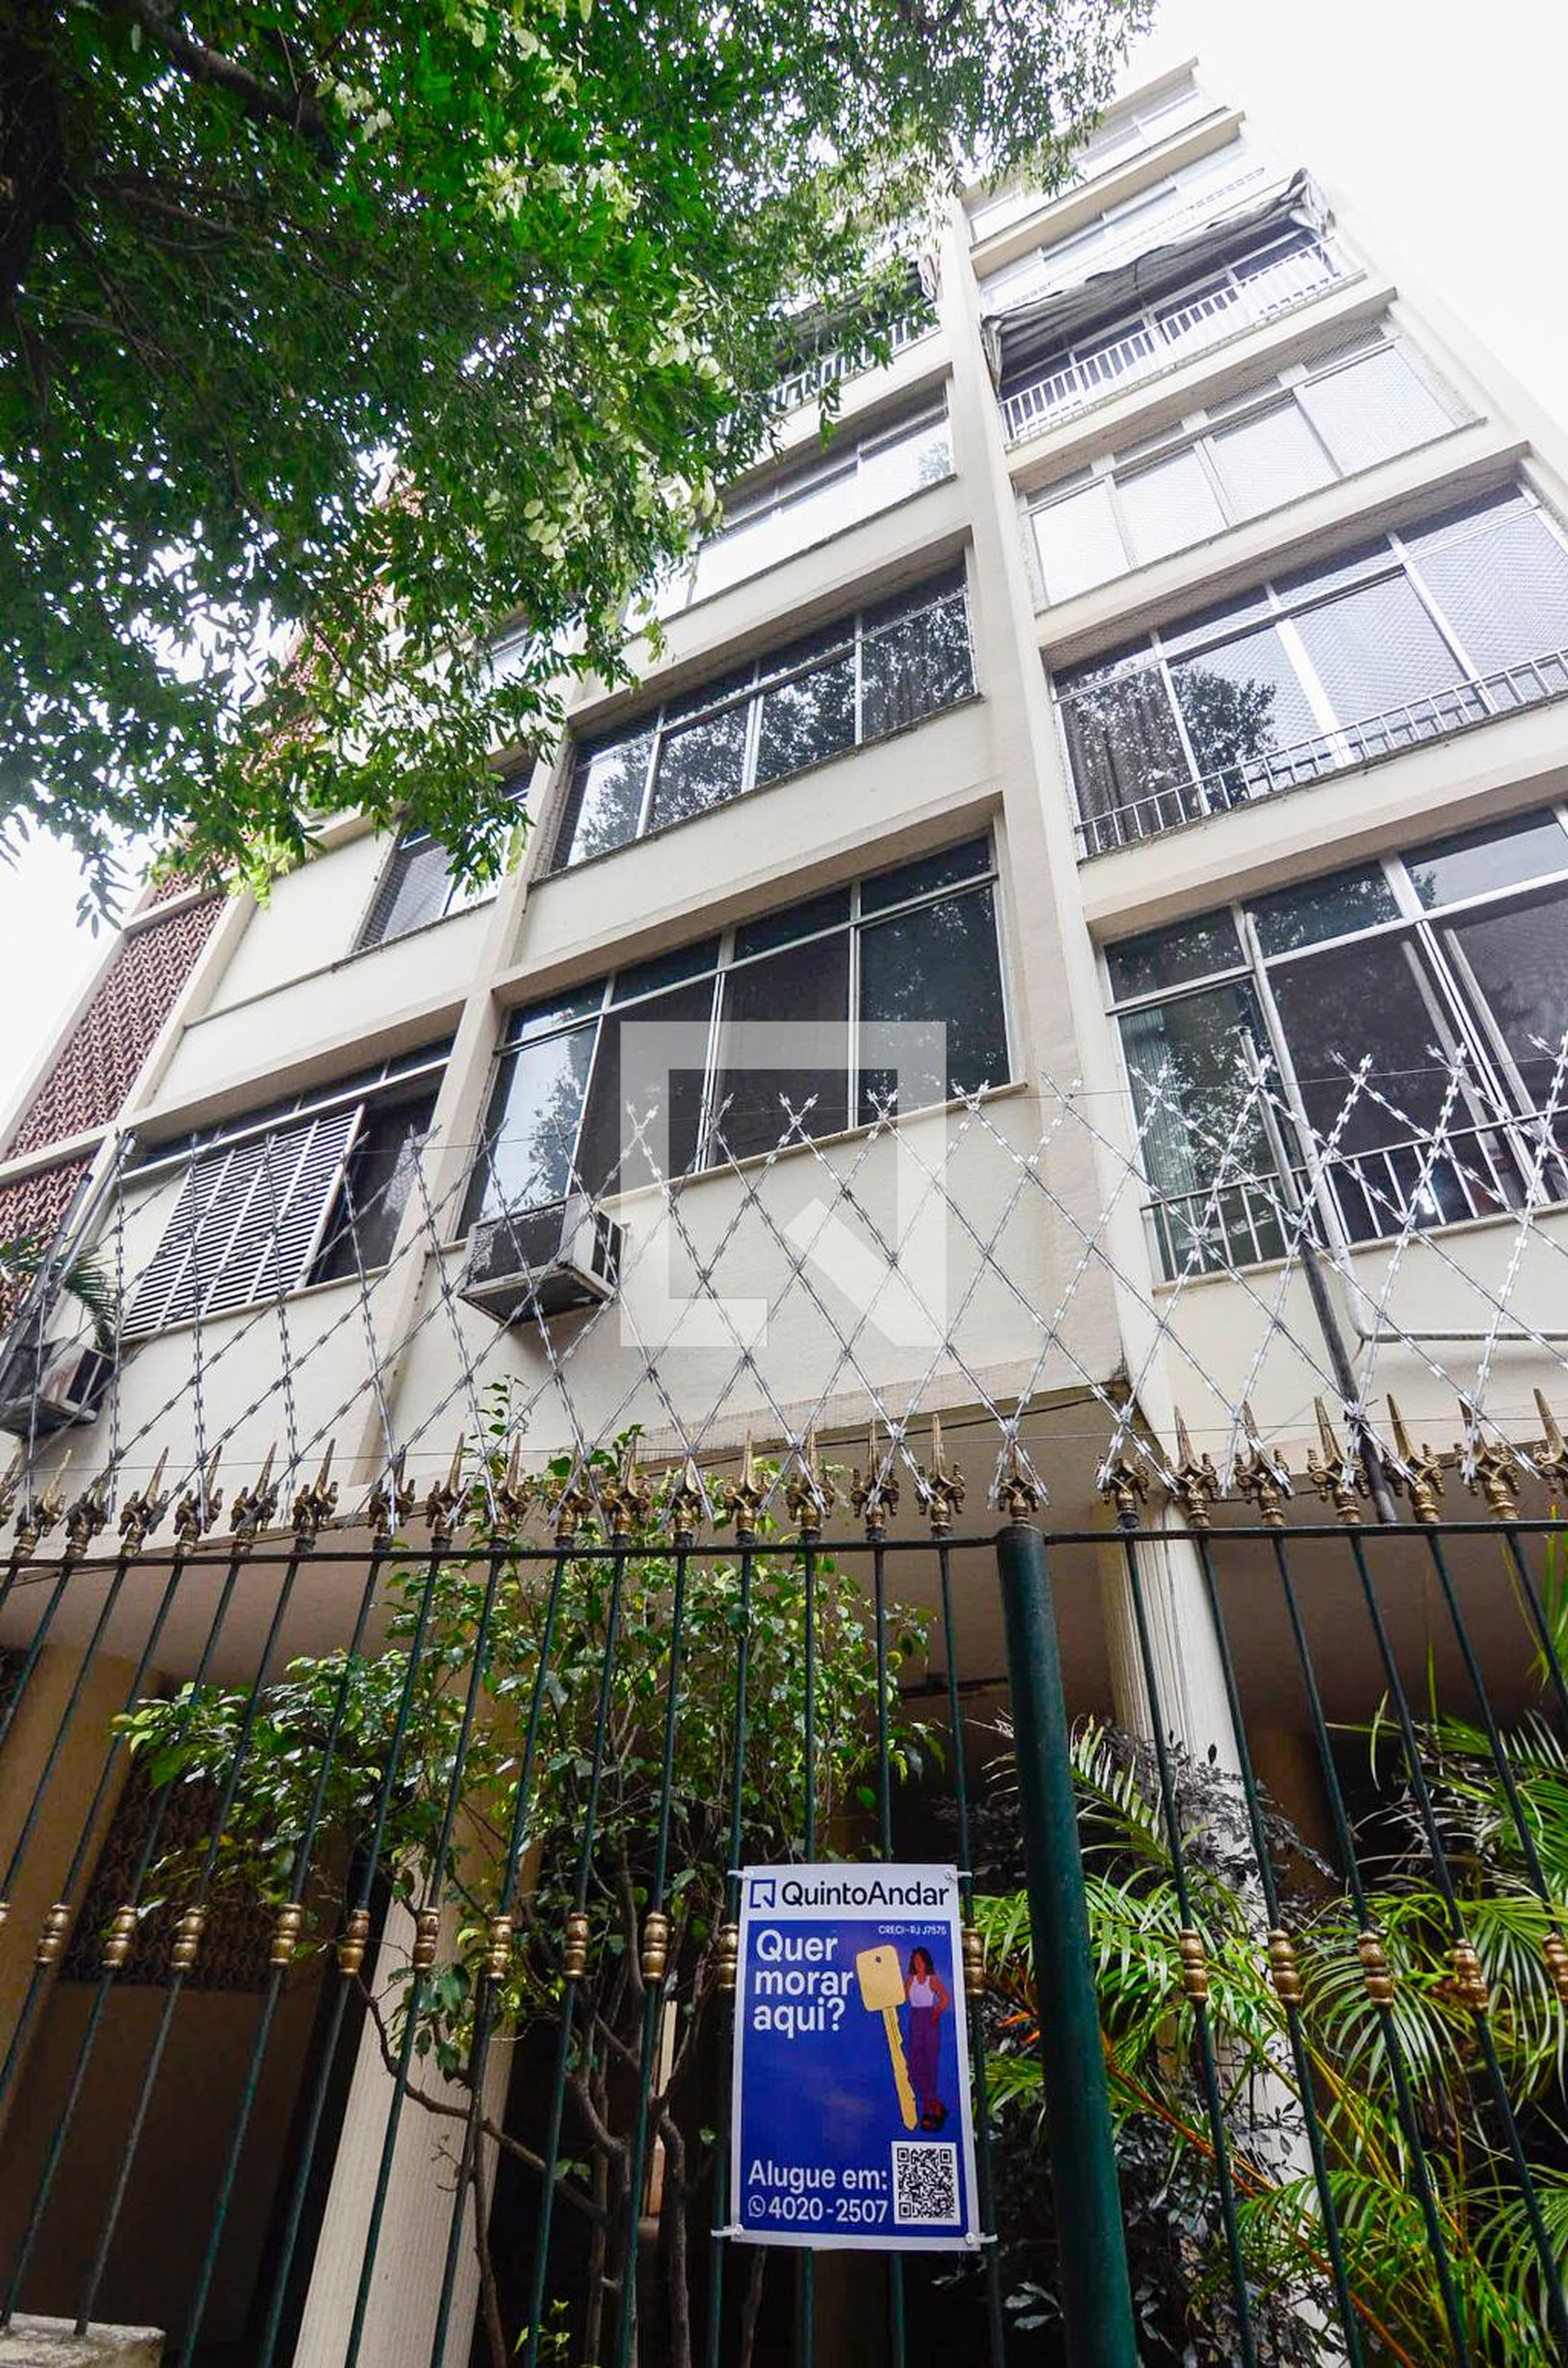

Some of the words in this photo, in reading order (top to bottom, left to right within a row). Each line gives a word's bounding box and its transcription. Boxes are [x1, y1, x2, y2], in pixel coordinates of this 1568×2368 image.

[782, 1880, 949, 1906] QuintoAndar
[756, 1929, 838, 1962] Quer
[754, 1970, 853, 1996] morar
[753, 1997, 845, 2039] aqui?
[748, 2159, 836, 2194] Alugue
[842, 2169, 887, 2190] em:
[768, 2196, 888, 2223] 4020-2507
